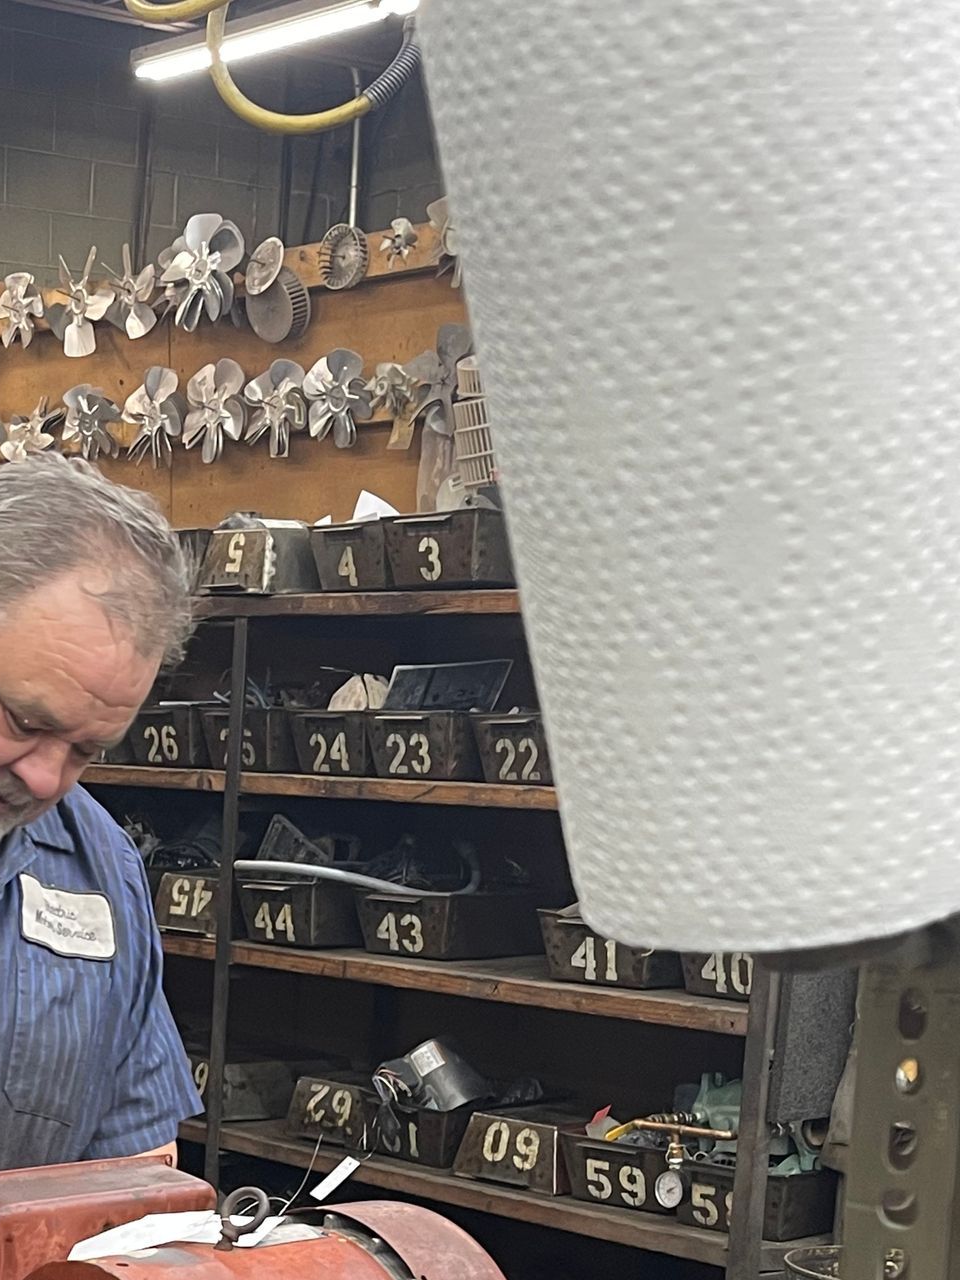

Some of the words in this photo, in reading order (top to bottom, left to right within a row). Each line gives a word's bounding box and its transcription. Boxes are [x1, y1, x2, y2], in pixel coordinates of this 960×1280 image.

[225, 533, 246, 573] 5
[338, 546, 358, 587] 4
[418, 537, 441, 581] 3
[144, 725, 179, 763] 26
[309, 732, 350, 772] 24
[386, 733, 431, 774] 23
[495, 738, 540, 780] 22
[169, 878, 213, 917] 45
[56, 922, 96, 941] Service
[254, 902, 295, 941] 44
[376, 912, 424, 953] 43
[570, 936, 618, 981] 41
[701, 952, 753, 994] 40
[586, 1158, 646, 1207] 59
